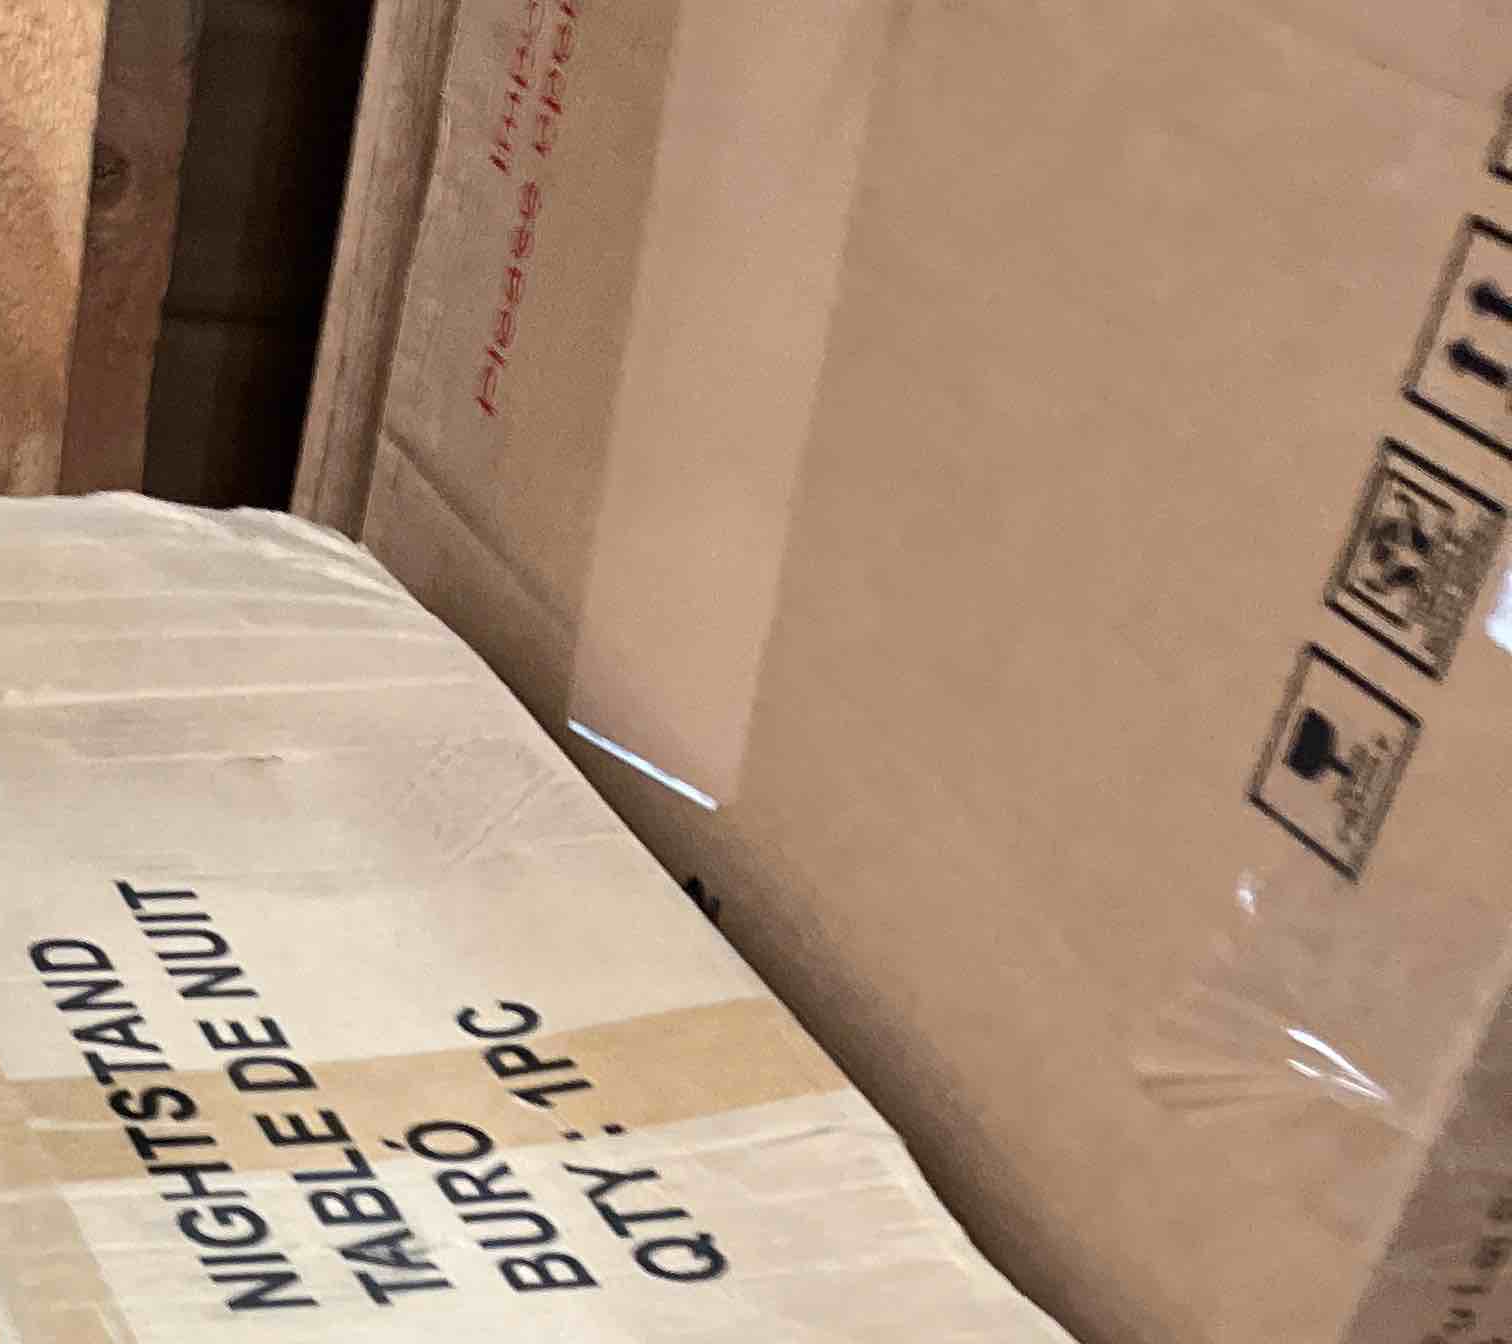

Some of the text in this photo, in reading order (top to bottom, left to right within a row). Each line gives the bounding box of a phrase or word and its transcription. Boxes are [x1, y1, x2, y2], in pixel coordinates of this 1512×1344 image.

[28, 938, 318, 1311] NIGHTSTAND
[115, 880, 453, 1305] TABLE DE NUIT
[456, 1000, 592, 1108] 1PC
[381, 1121, 600, 1292] BURÓ
[562, 1163, 728, 1282] QTY
